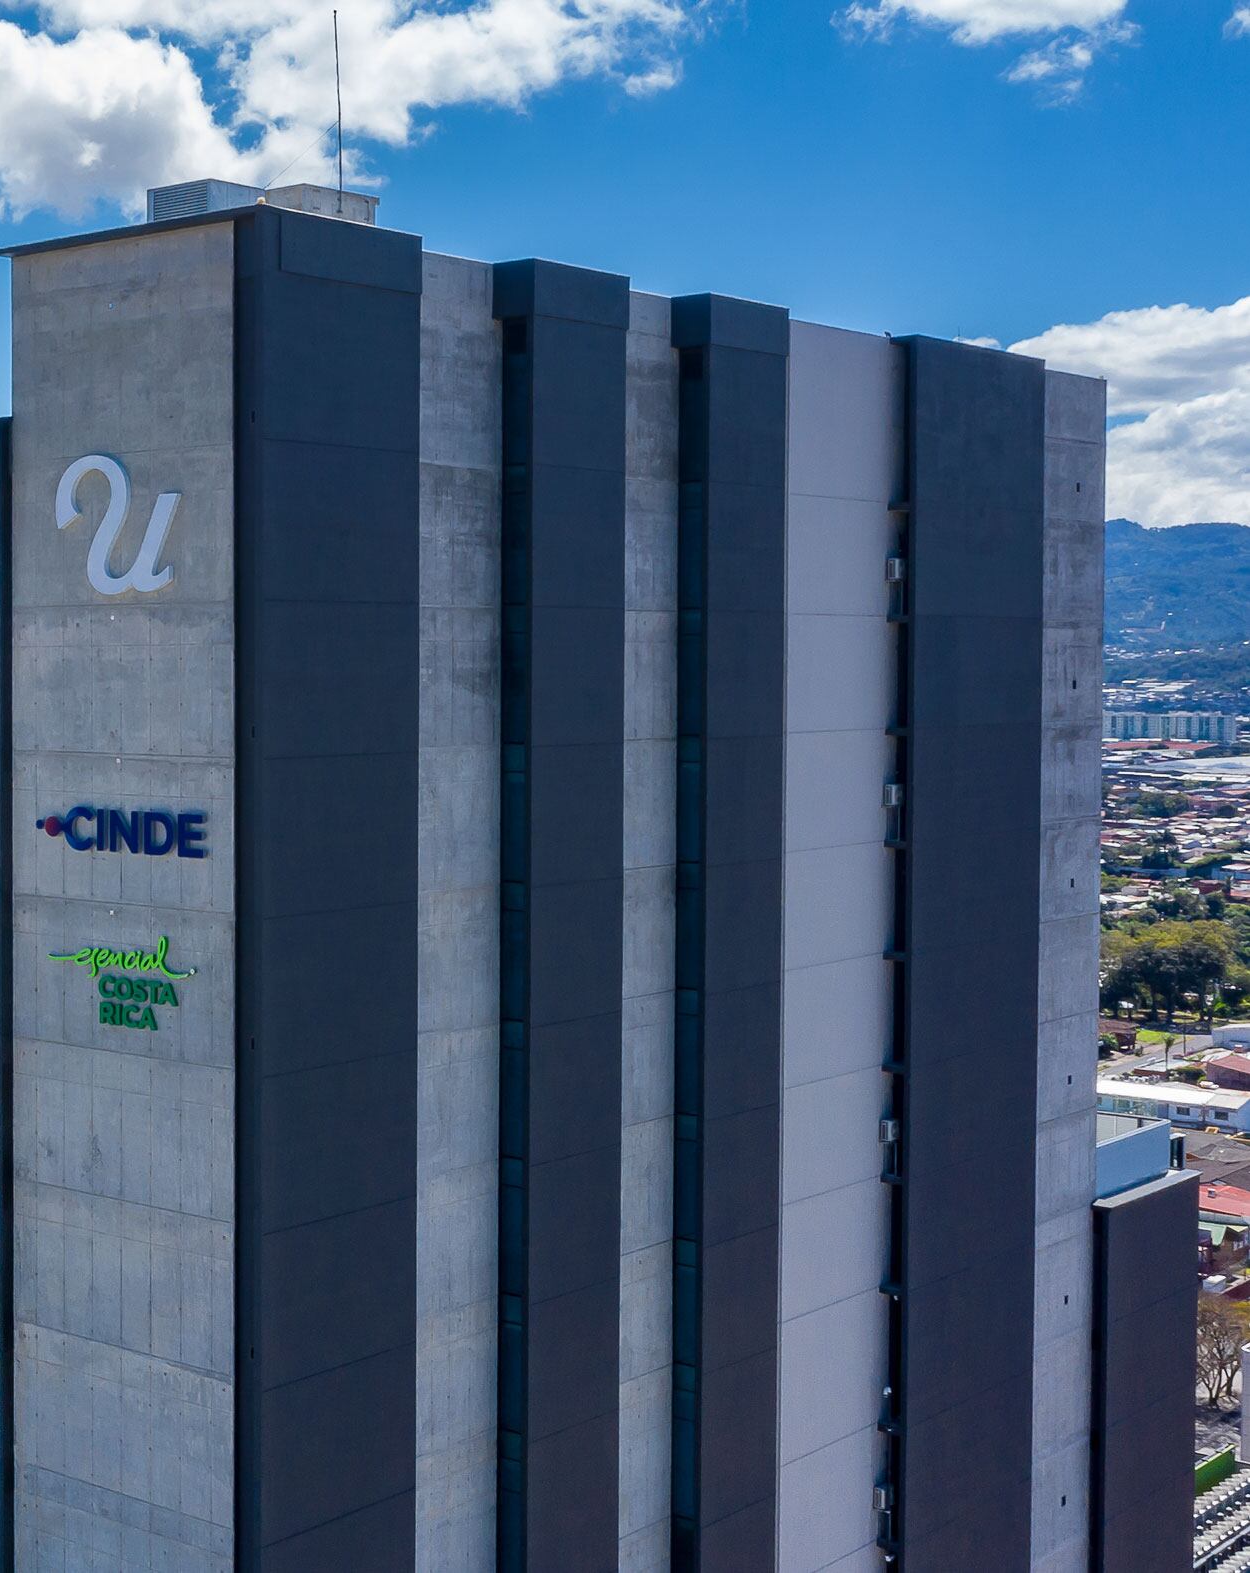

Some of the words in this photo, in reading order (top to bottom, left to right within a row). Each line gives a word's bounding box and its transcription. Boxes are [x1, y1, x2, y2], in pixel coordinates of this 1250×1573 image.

[63, 806, 207, 859] CINDE
[48, 935, 195, 980] esencial
[99, 975, 178, 1007] COSTA
[100, 1001, 158, 1031] RICA
